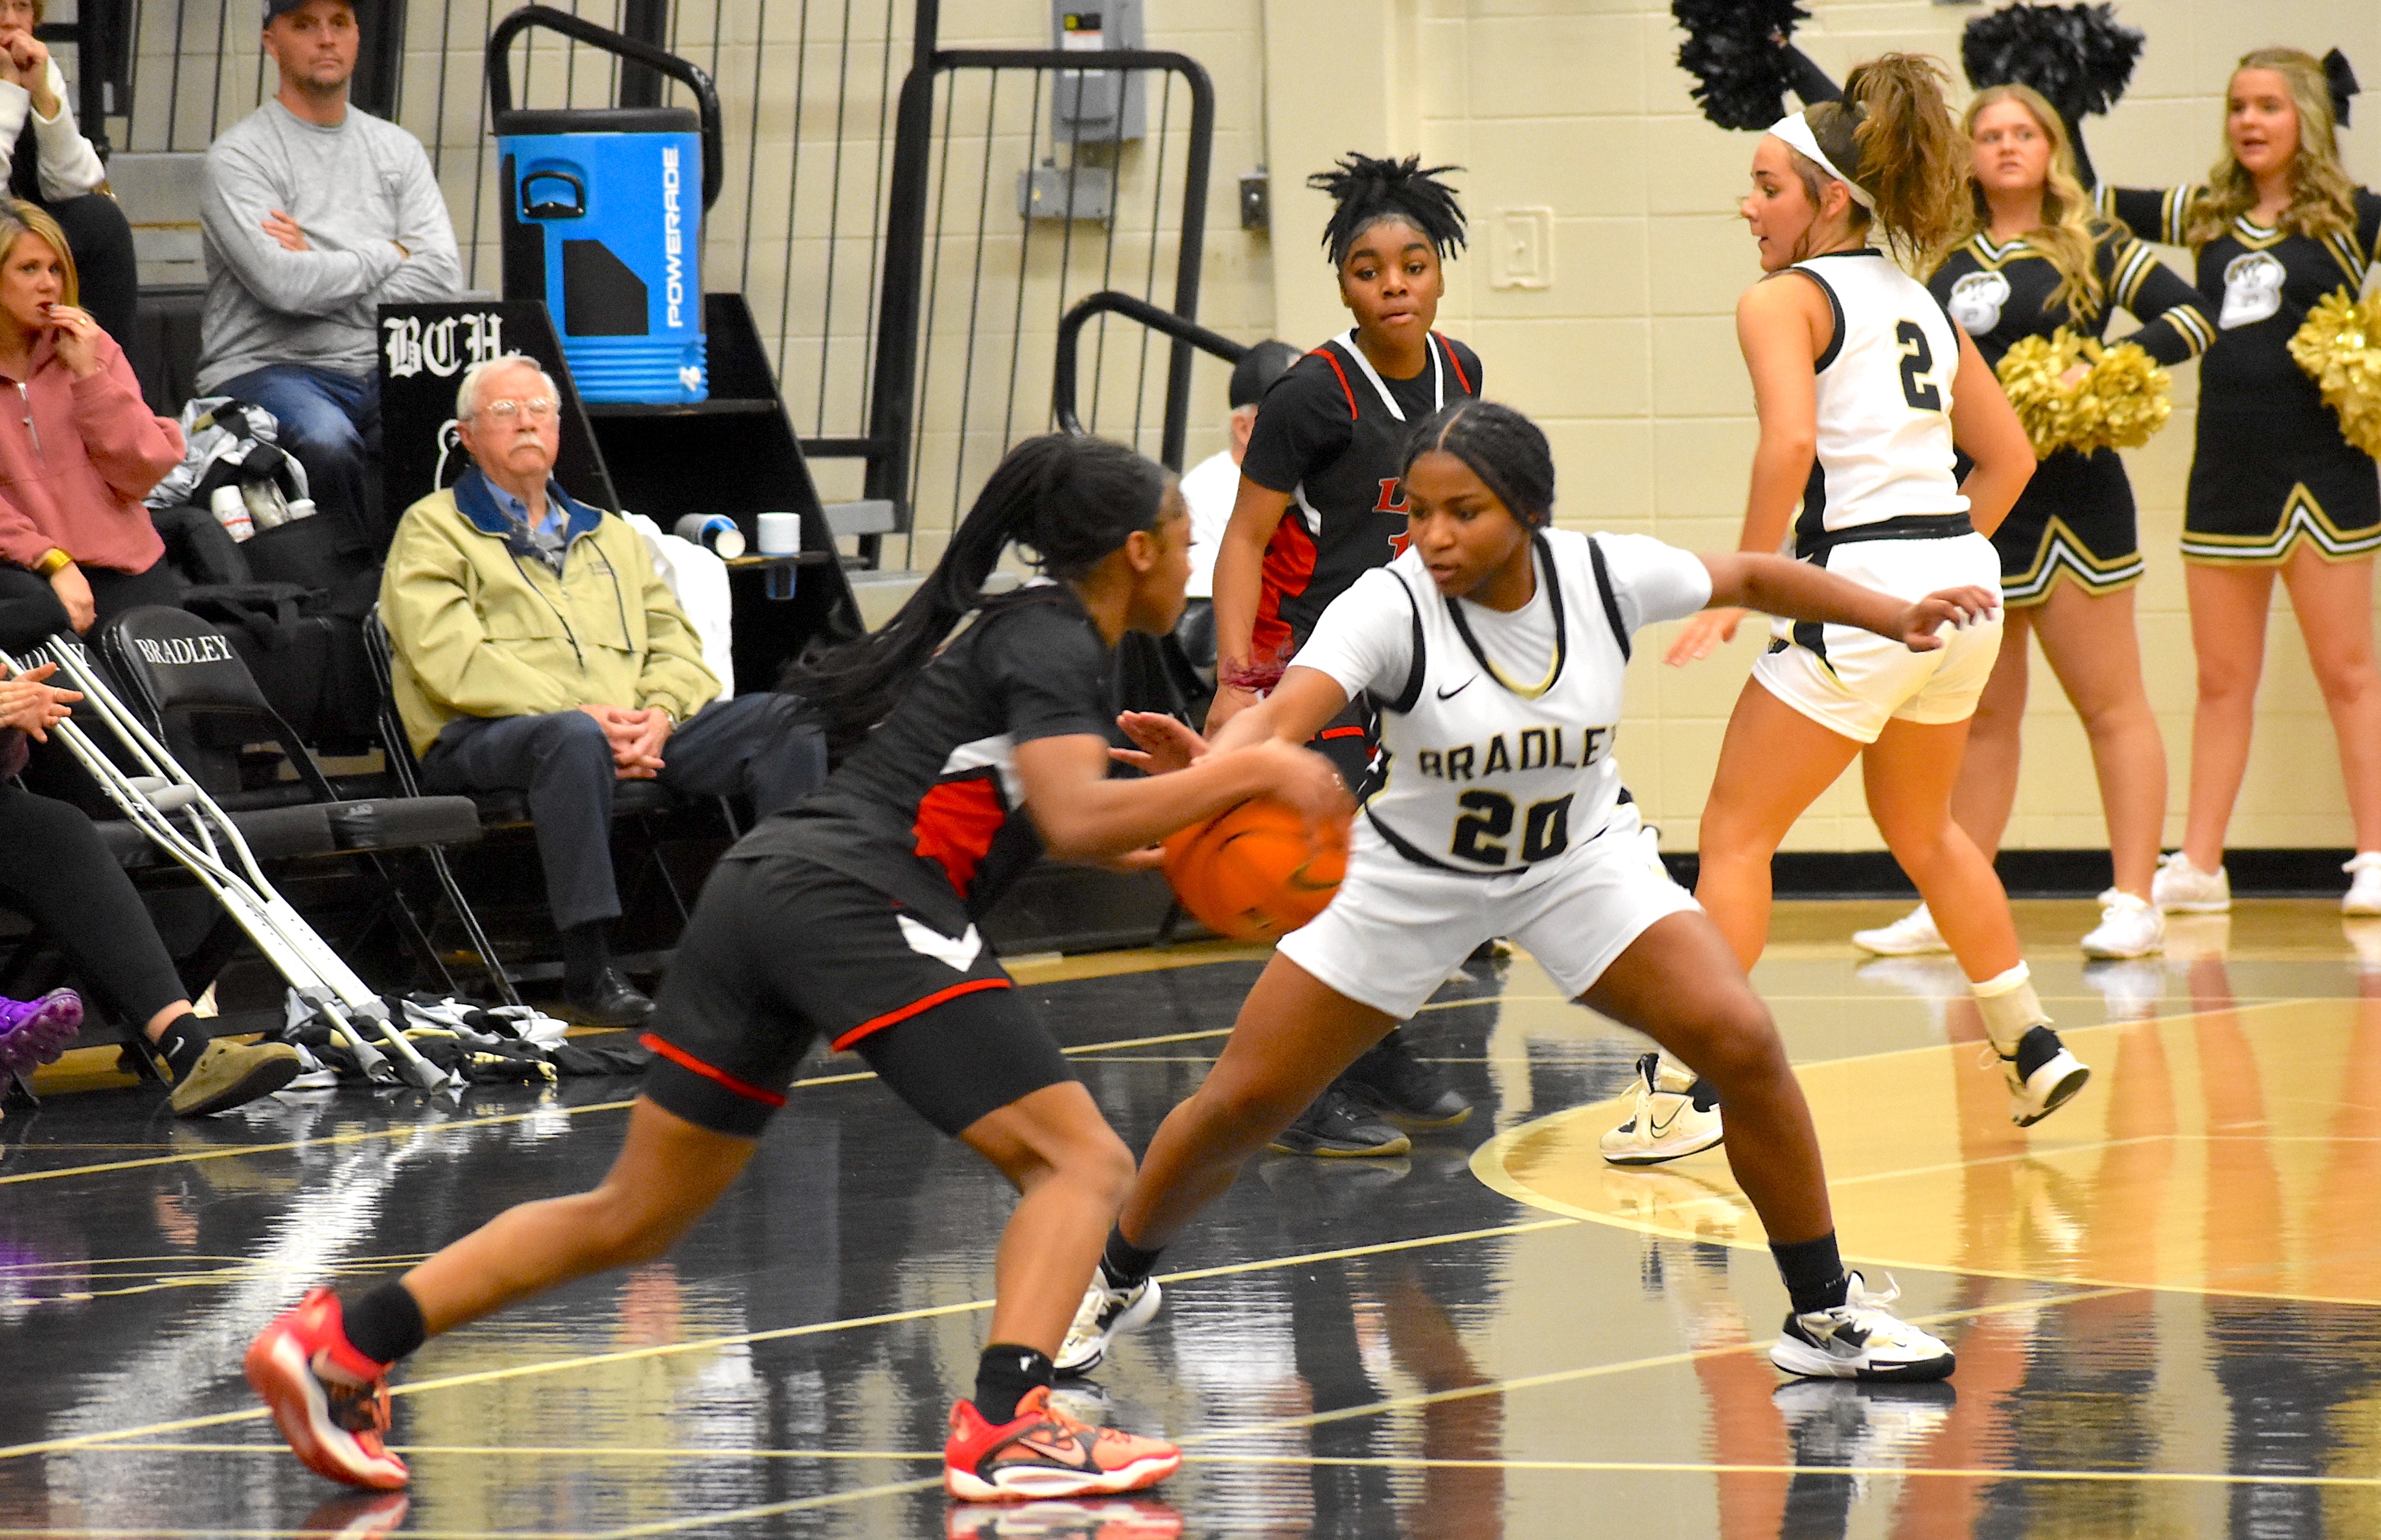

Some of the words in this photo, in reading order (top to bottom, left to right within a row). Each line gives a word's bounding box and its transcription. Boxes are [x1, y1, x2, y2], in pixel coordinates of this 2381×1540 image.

[662, 147, 684, 328] POWERADE
[1895, 317, 1942, 412] 2
[134, 634, 233, 664] BRADLEY
[1418, 723, 1618, 782] BRADLE
[1450, 789, 1576, 866] 20
